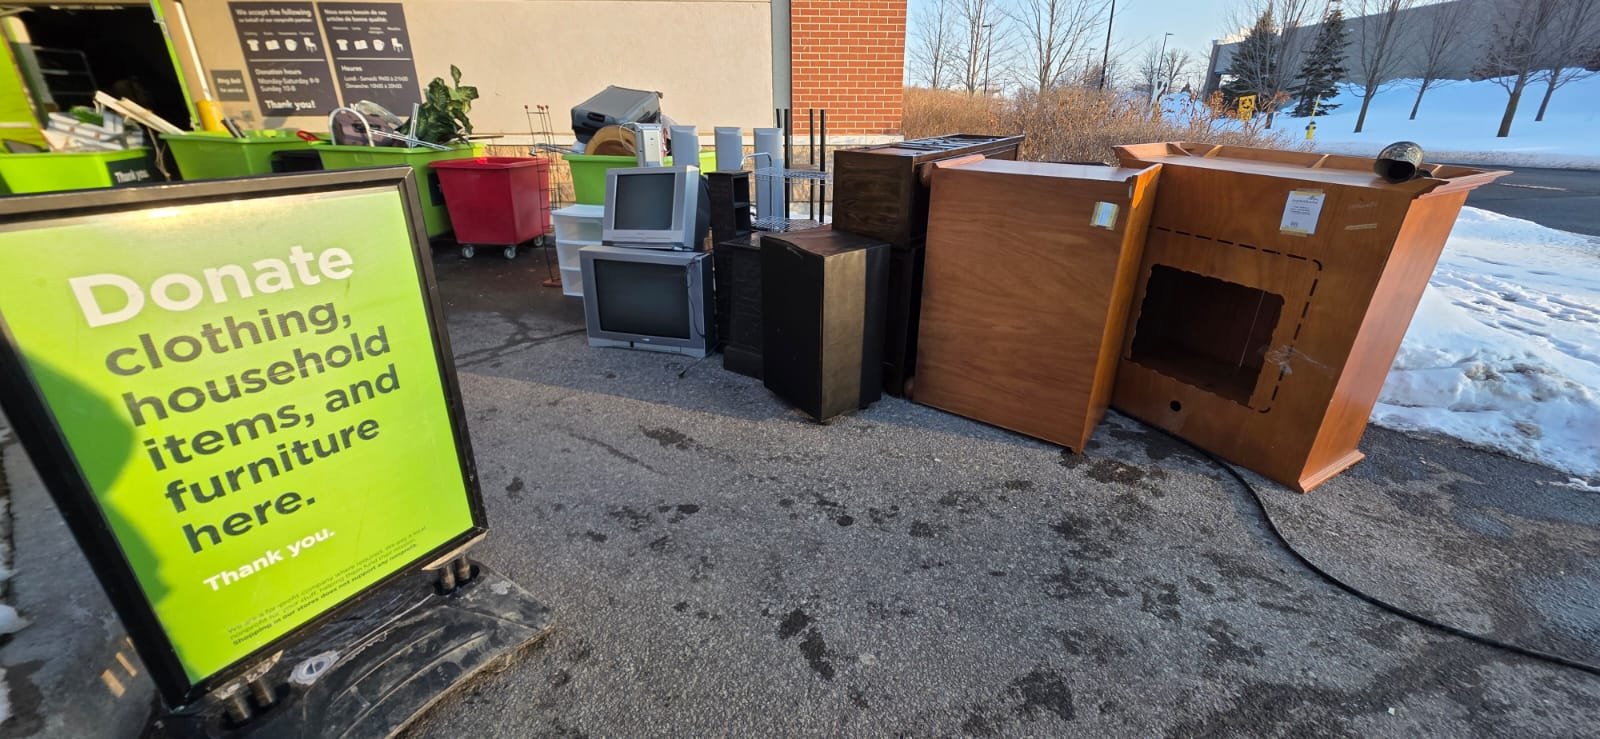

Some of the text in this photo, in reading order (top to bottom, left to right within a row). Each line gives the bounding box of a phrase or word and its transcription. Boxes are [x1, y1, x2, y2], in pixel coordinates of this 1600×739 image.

[281, 8, 312, 18] following
[260, 85, 282, 93] Sunday
[341, 64, 363, 72] Heures
[264, 99, 316, 111] Thank you!
[114, 169, 137, 184] Thank
[68, 244, 354, 328] Donate
[105, 302, 352, 376] clothing,
[122, 324, 390, 427] household
[144, 363, 401, 472] items, and
[164, 418, 380, 514] furniture
[182, 490, 316, 554] here.
[202, 528, 336, 592] Thank you.
